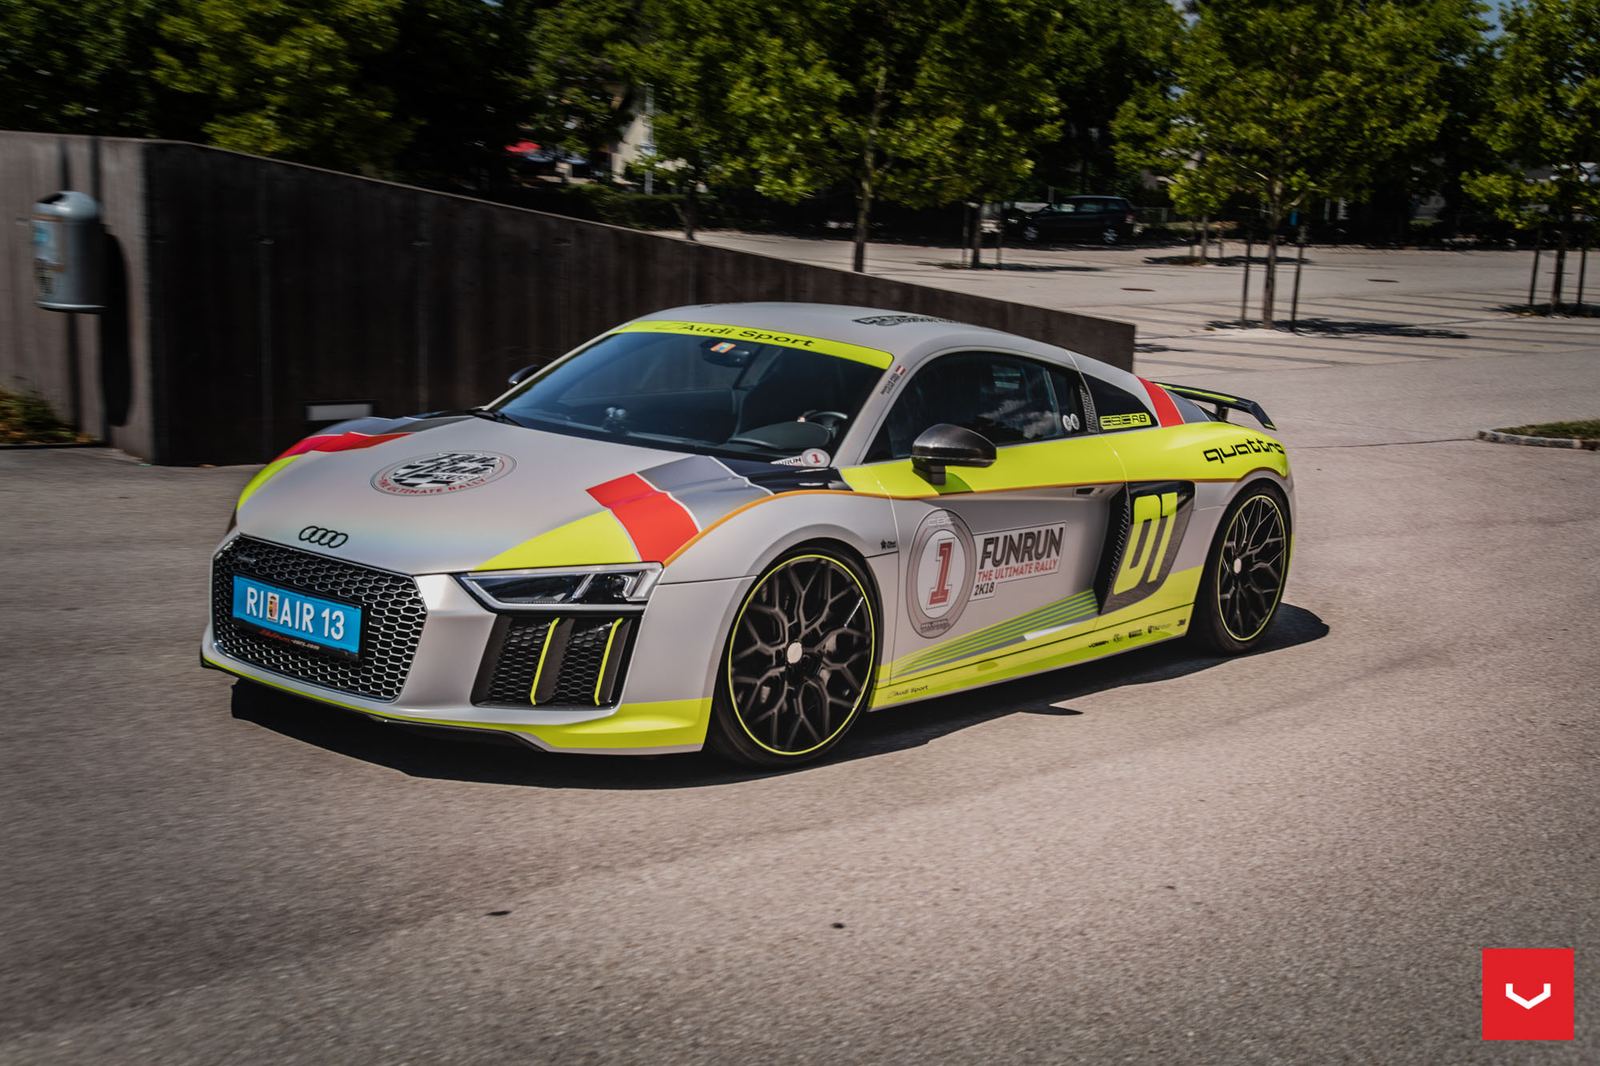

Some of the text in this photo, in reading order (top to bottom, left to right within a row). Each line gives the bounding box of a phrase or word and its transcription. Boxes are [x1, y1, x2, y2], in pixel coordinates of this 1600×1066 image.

[680, 323, 815, 347] Audi Sport
[812, 453, 821, 464] 1
[1203, 438, 1285, 464] quattro
[447, 478, 485, 491] RALLY
[979, 527, 1064, 570] FUNRUN
[1113, 492, 1178, 595] 01
[928, 541, 954, 606] 1
[977, 559, 1058, 582] THE ULTIMATE RALLY
[974, 582, 995, 596] 2K18
[246, 587, 345, 640] RI AIR 13
